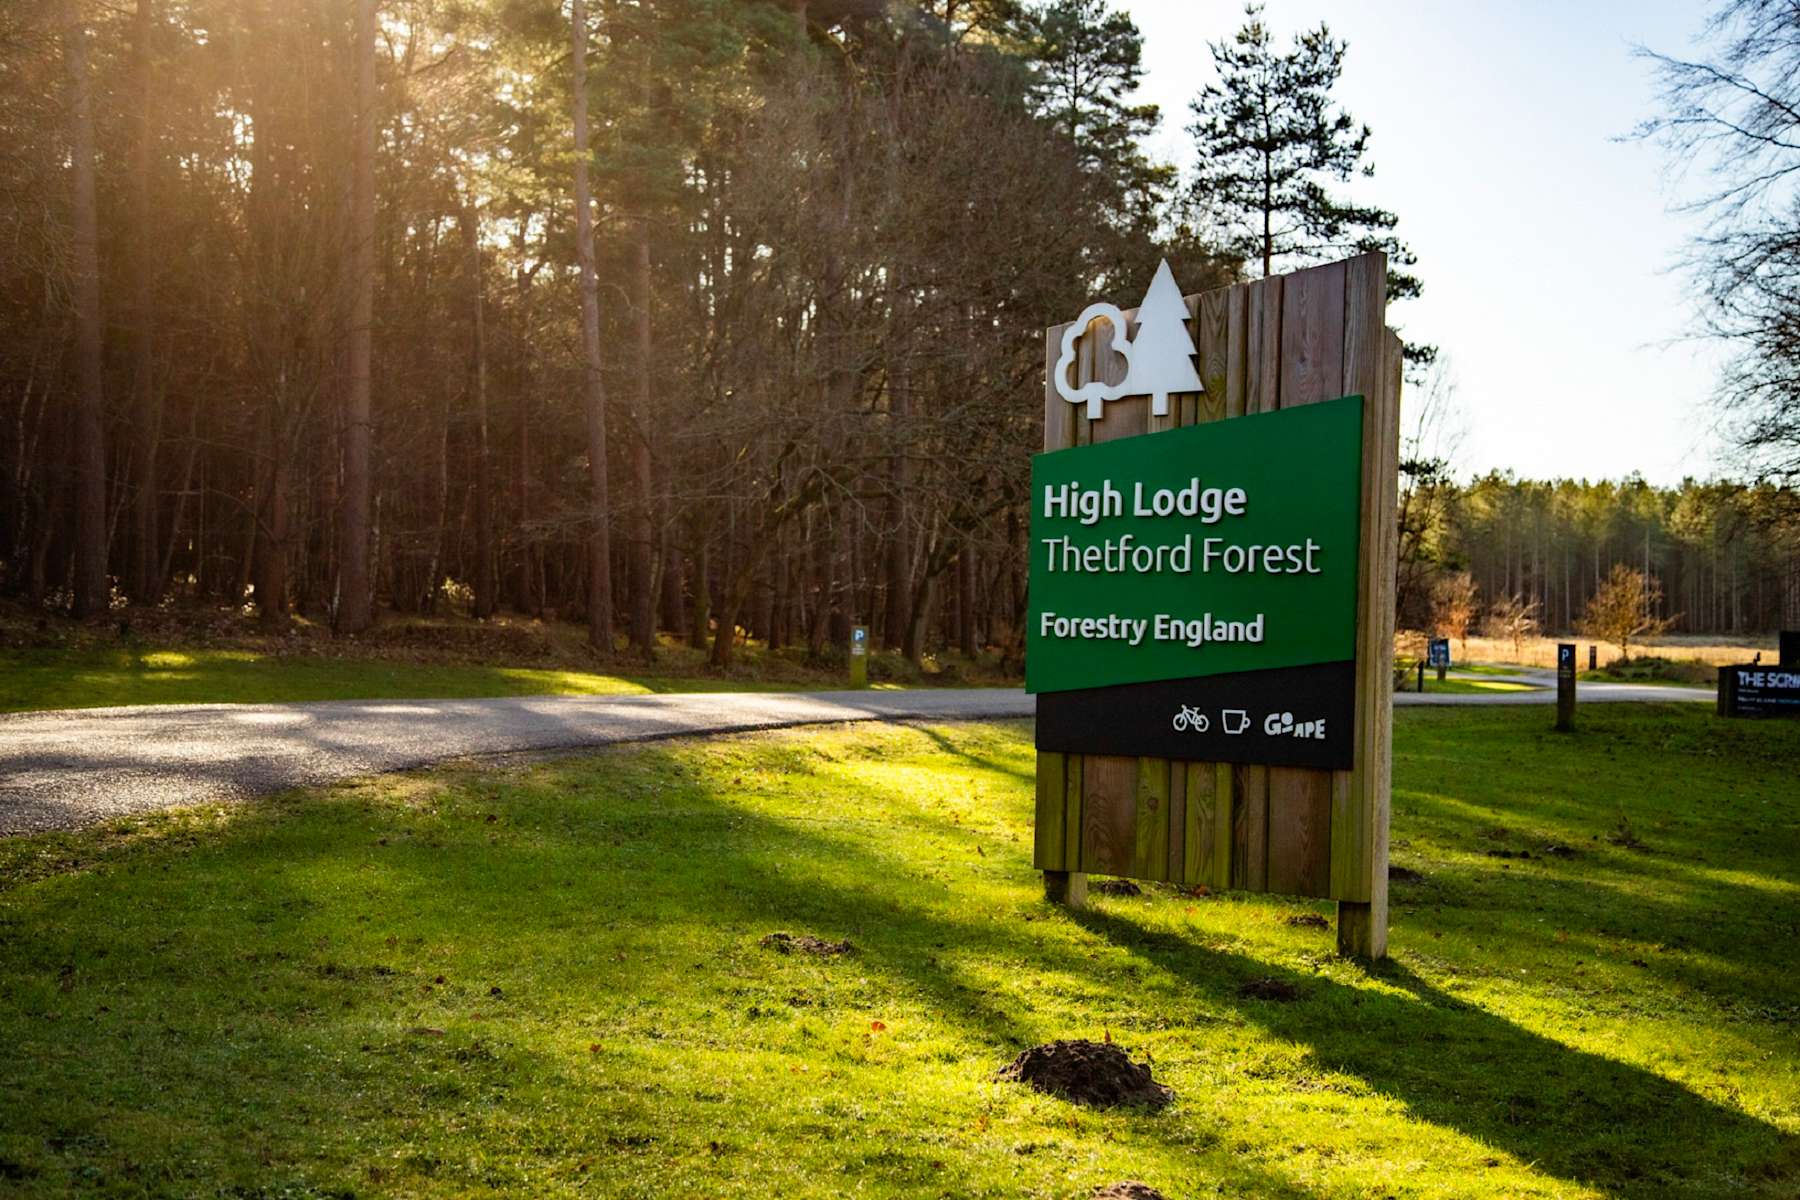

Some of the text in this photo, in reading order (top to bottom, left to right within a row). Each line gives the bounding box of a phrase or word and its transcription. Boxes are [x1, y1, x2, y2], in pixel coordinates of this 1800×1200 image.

[1043, 477, 1248, 525] High Lodge
[1041, 534, 1322, 574] Thetford Forest
[855, 629, 864, 641] P
[1040, 612, 1265, 648] Forestry England
[1562, 648, 1570, 661] P
[1737, 671, 1800, 689] THE SCRI
